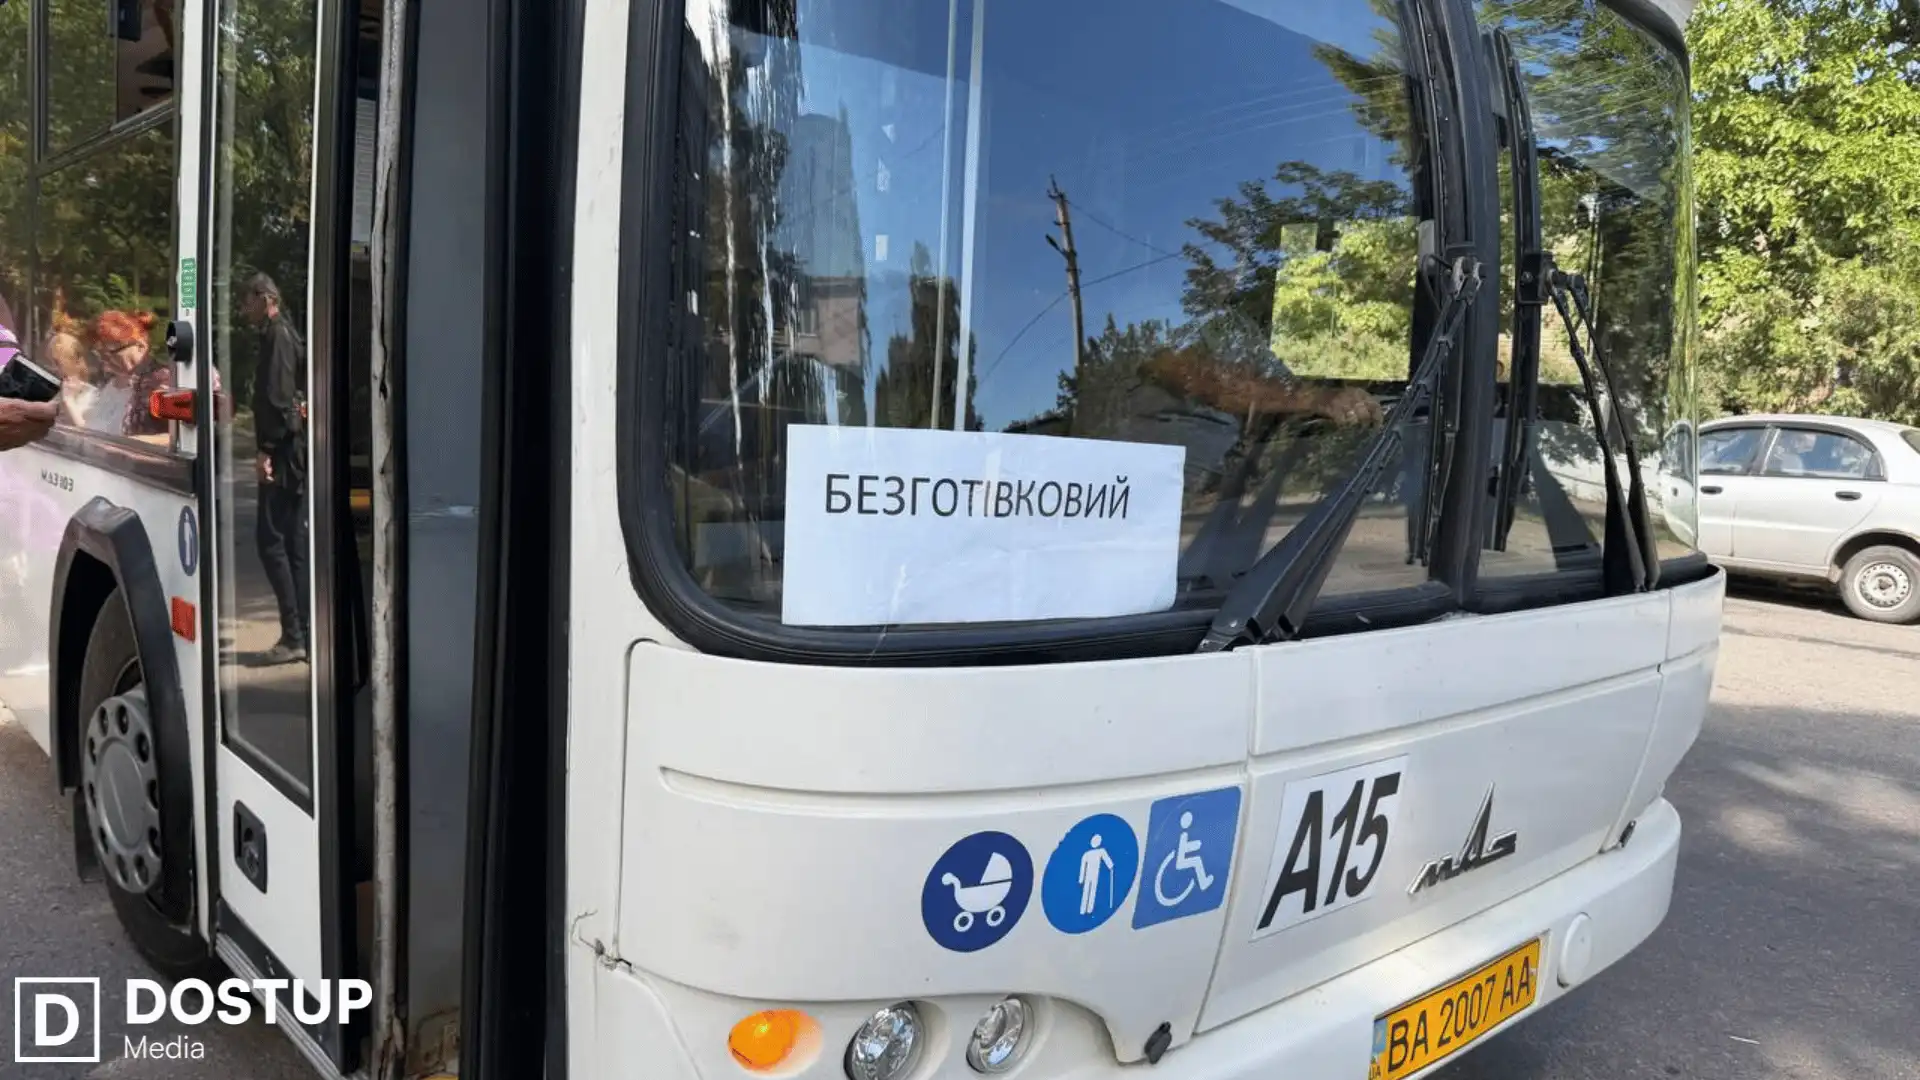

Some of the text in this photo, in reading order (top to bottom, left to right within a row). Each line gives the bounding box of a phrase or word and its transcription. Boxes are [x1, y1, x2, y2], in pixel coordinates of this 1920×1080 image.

[825, 474, 1130, 519] БЕЗГОТІВКОВИЙ
[1256, 771, 1401, 930] A15
[1388, 956, 1530, 1073] BA 2007 AA
